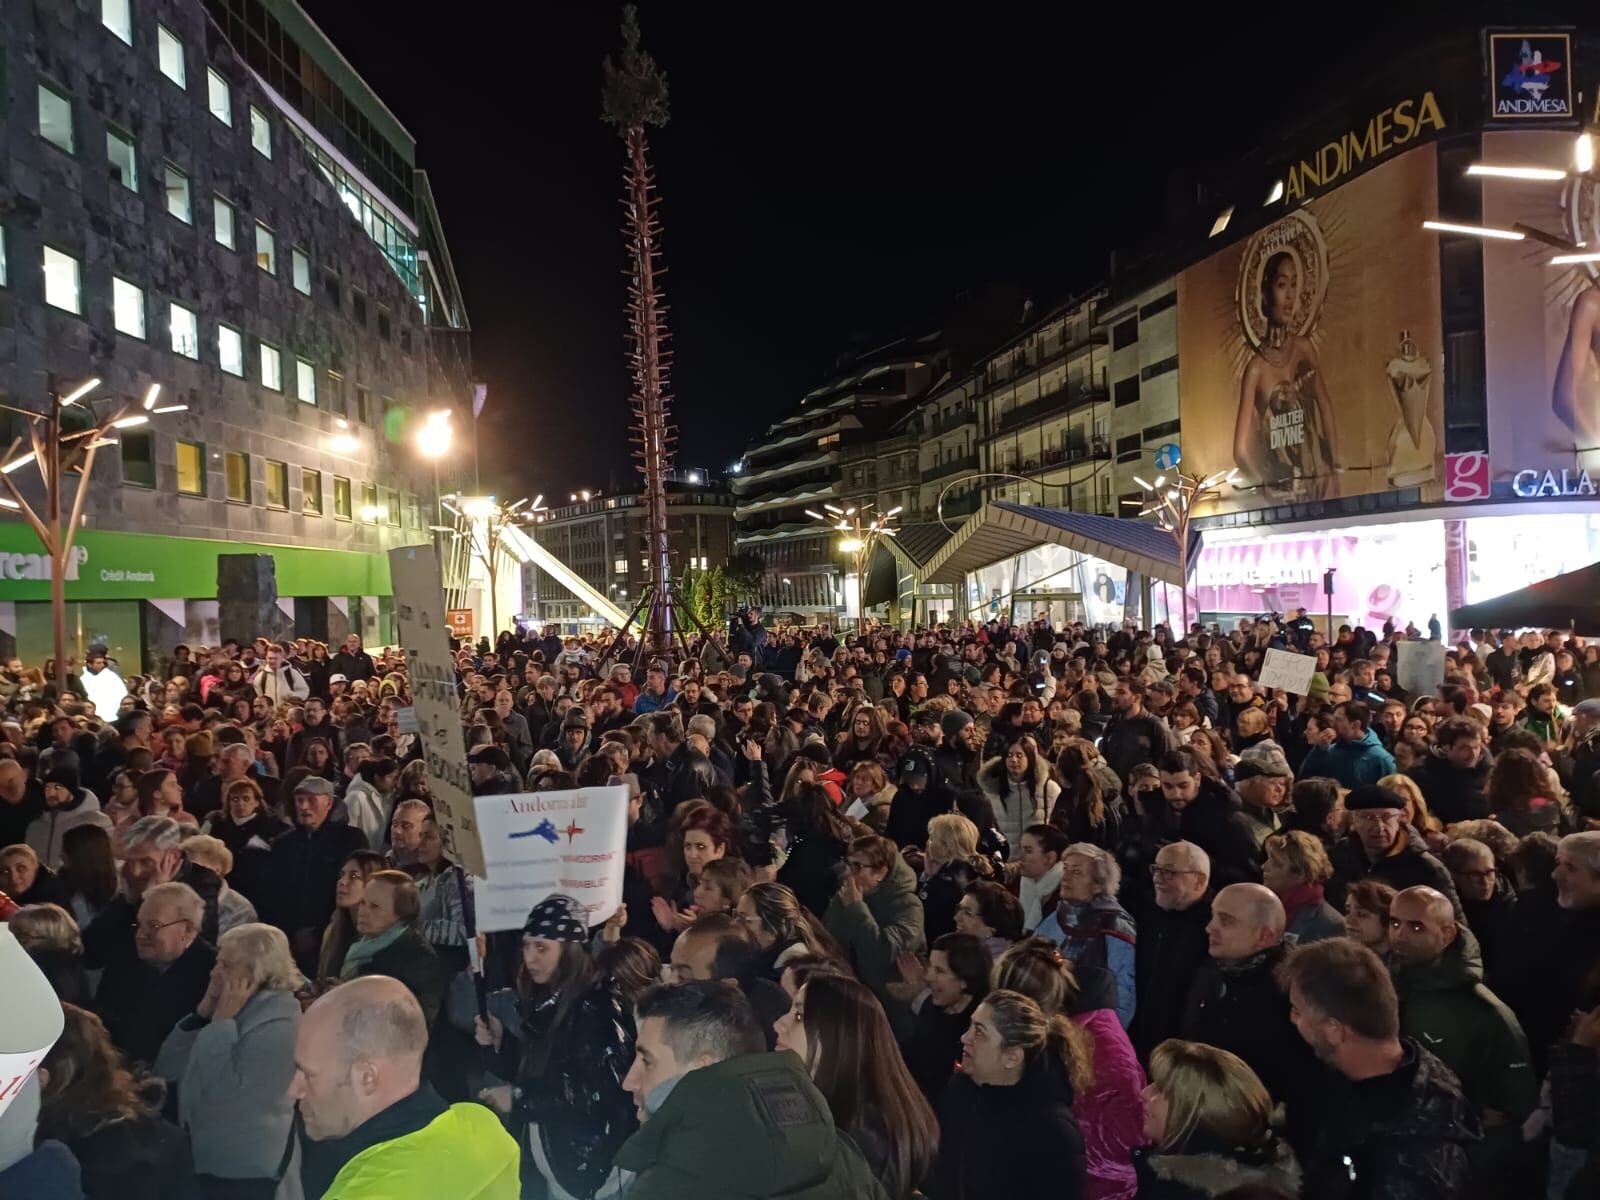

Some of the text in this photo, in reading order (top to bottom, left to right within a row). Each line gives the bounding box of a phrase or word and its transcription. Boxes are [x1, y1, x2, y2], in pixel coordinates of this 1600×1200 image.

[1497, 98, 1568, 114] ANDIMESA
[1285, 91, 1446, 206] ANDIMESA
[1270, 409, 1304, 429] GAULTIER
[1270, 424, 1305, 449] DIVINE
